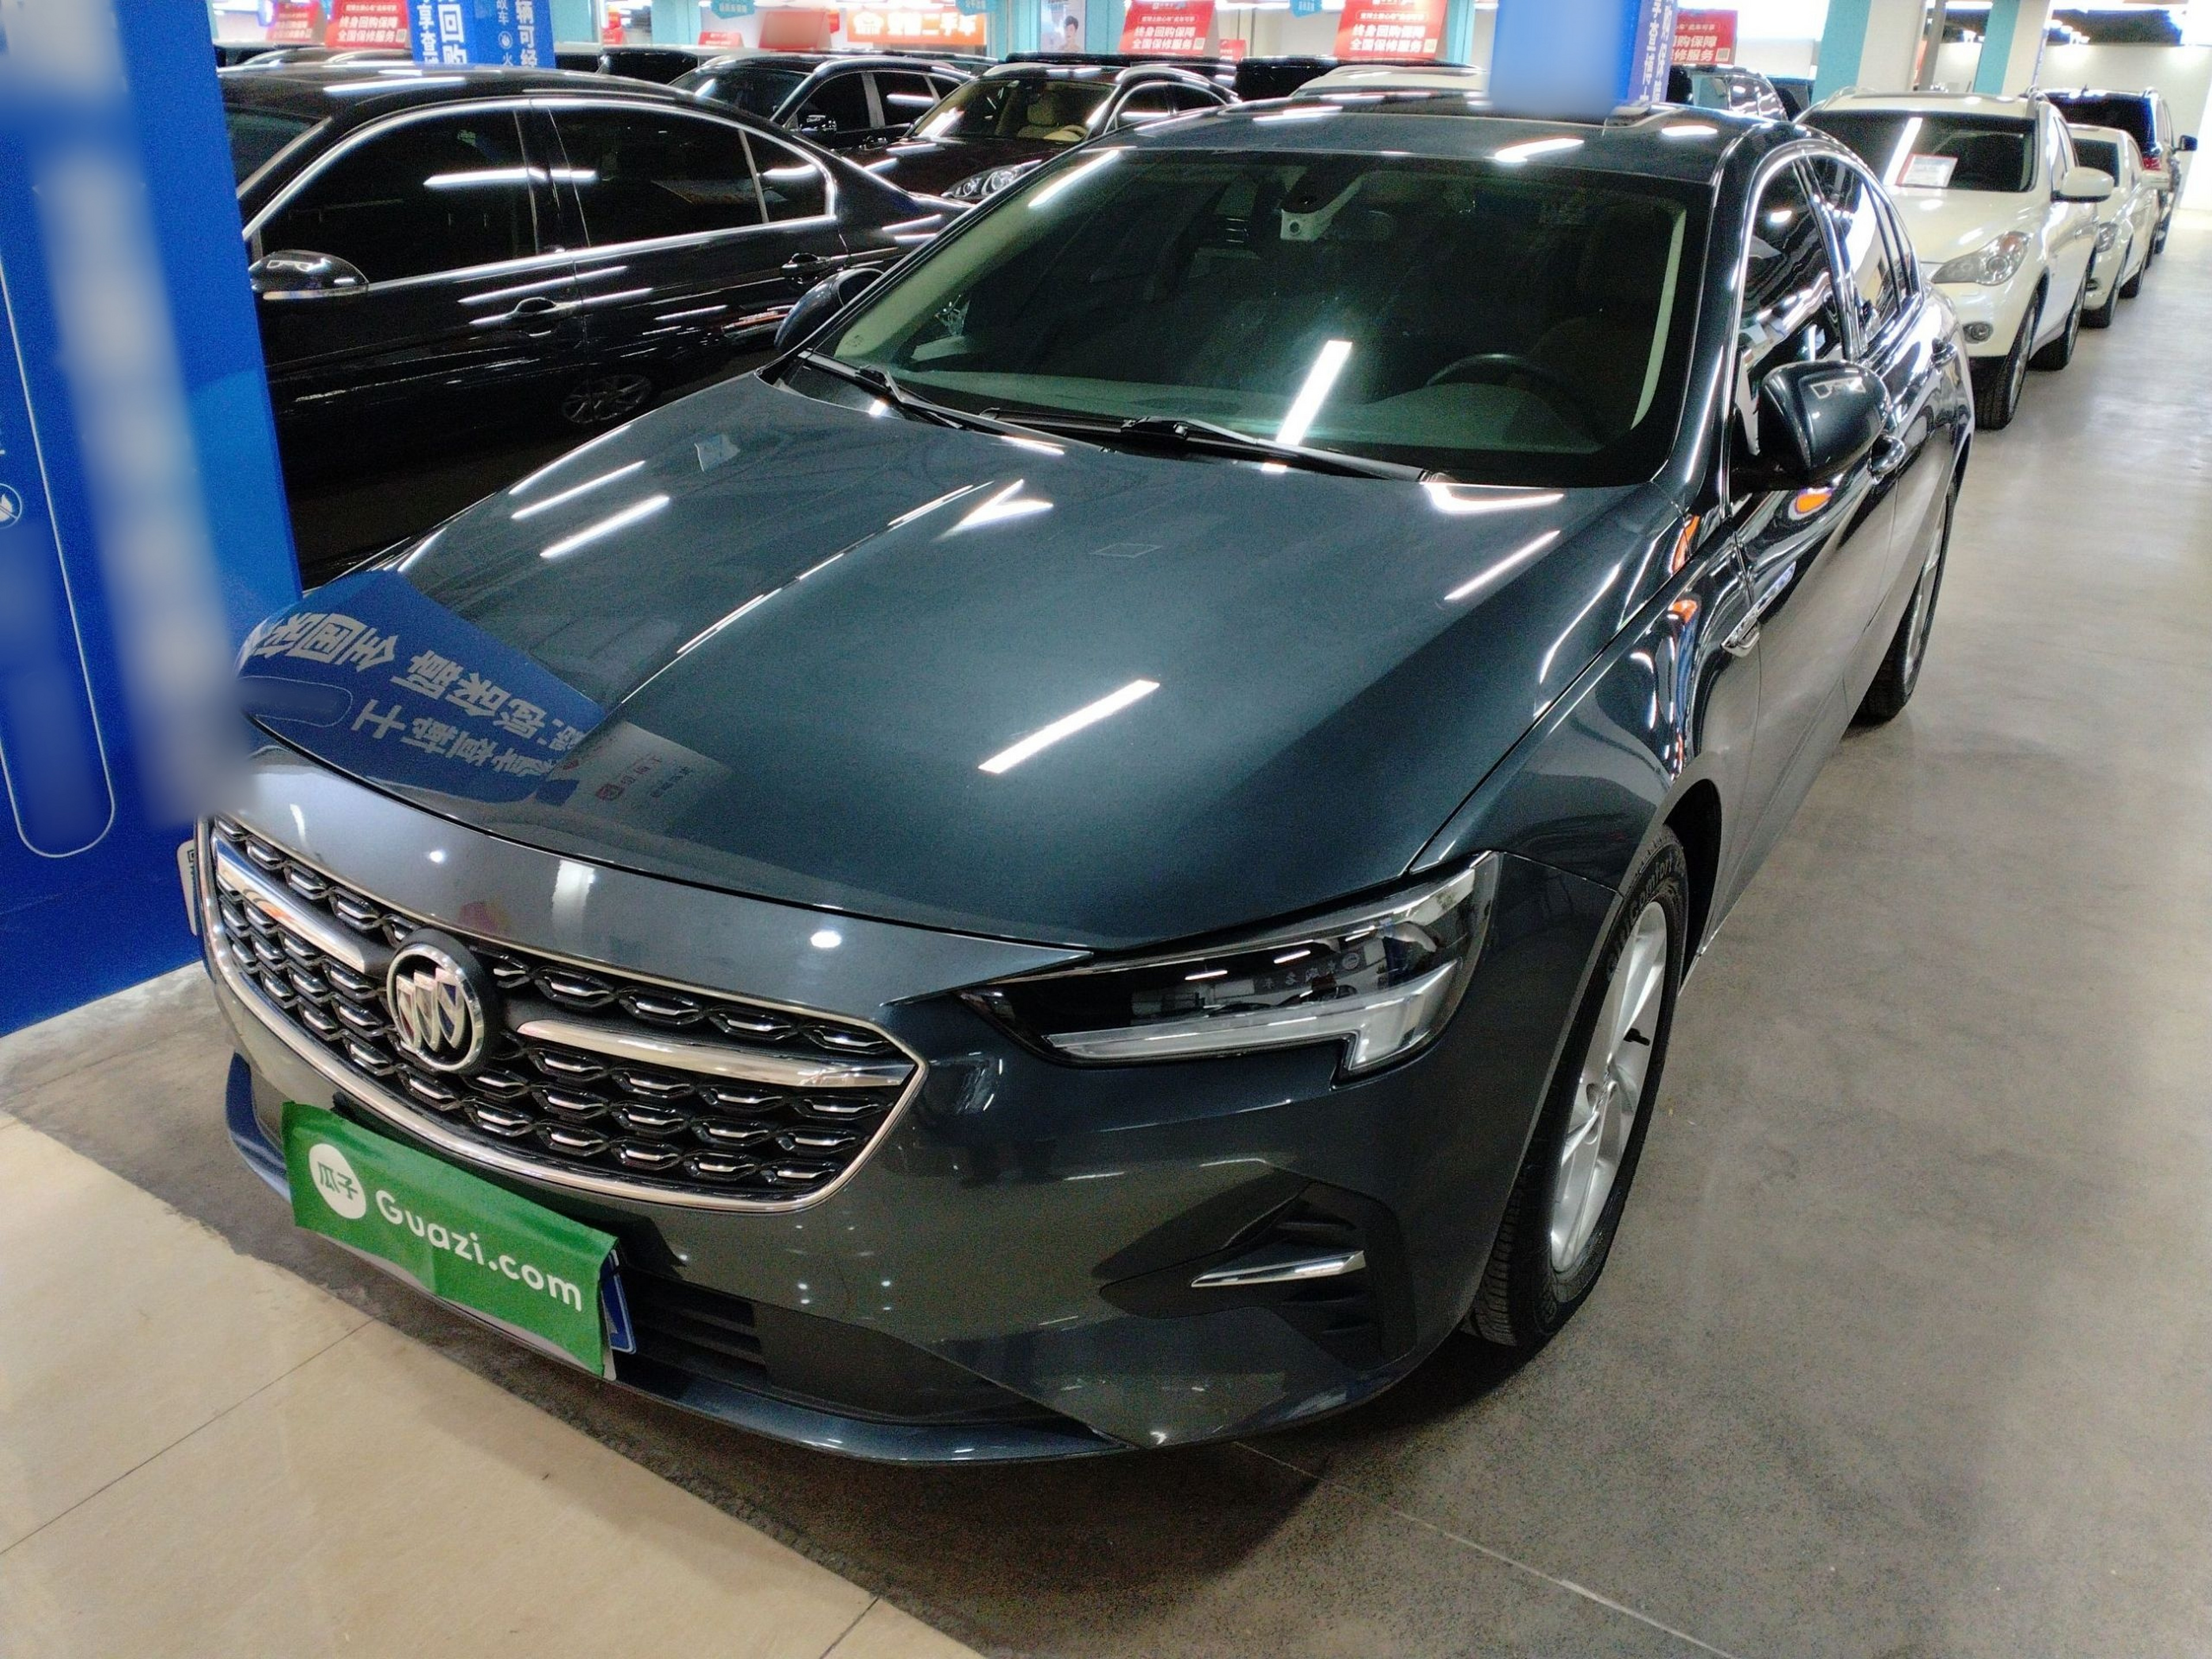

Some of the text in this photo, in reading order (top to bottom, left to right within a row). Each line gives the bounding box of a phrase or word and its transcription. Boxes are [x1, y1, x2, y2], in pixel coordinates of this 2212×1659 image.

[438, 0, 467, 63] 回购
[1671, 49, 1714, 62] 修服务
[317, 1161, 358, 1200] 瓜子
[376, 1190, 582, 1312] Guazi.com
